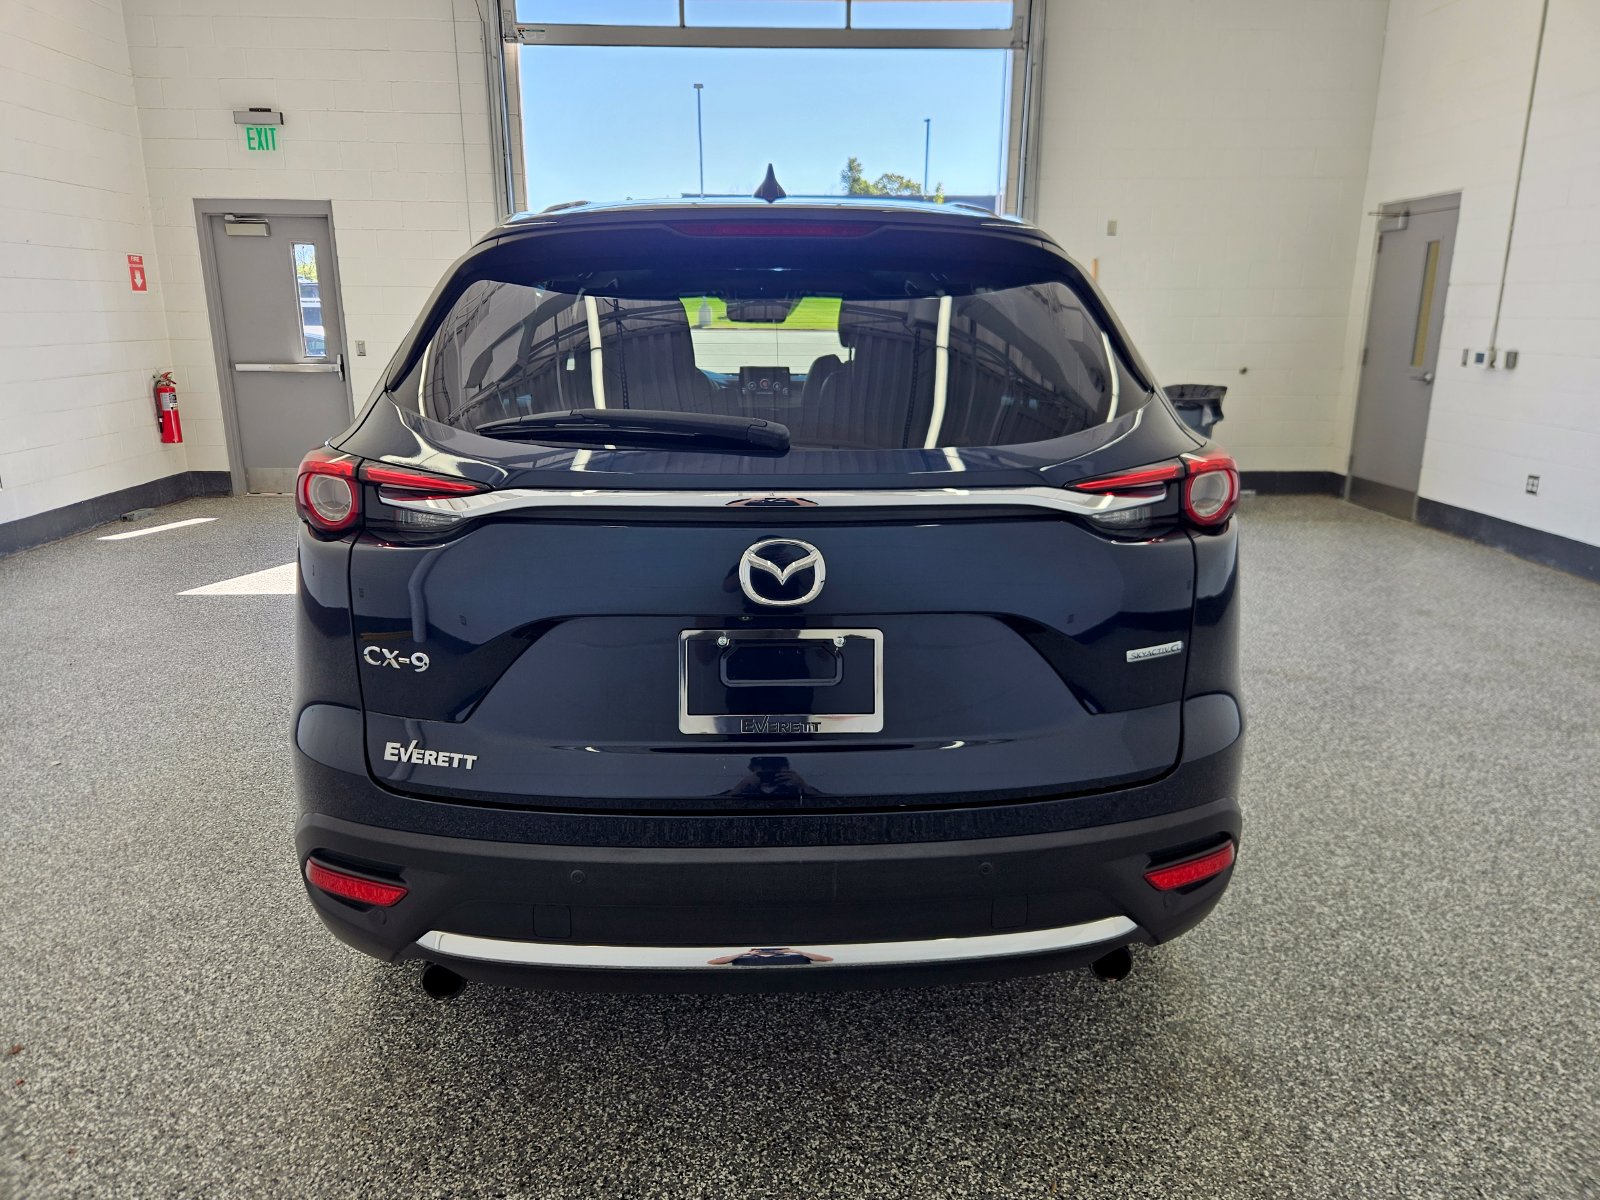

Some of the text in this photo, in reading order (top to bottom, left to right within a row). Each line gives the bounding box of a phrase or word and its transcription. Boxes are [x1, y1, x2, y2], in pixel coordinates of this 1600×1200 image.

[246, 127, 276, 151] EXIT
[363, 645, 430, 673] CX-9
[740, 715, 822, 734] EVERETT
[383, 739, 478, 770] EVERETT
